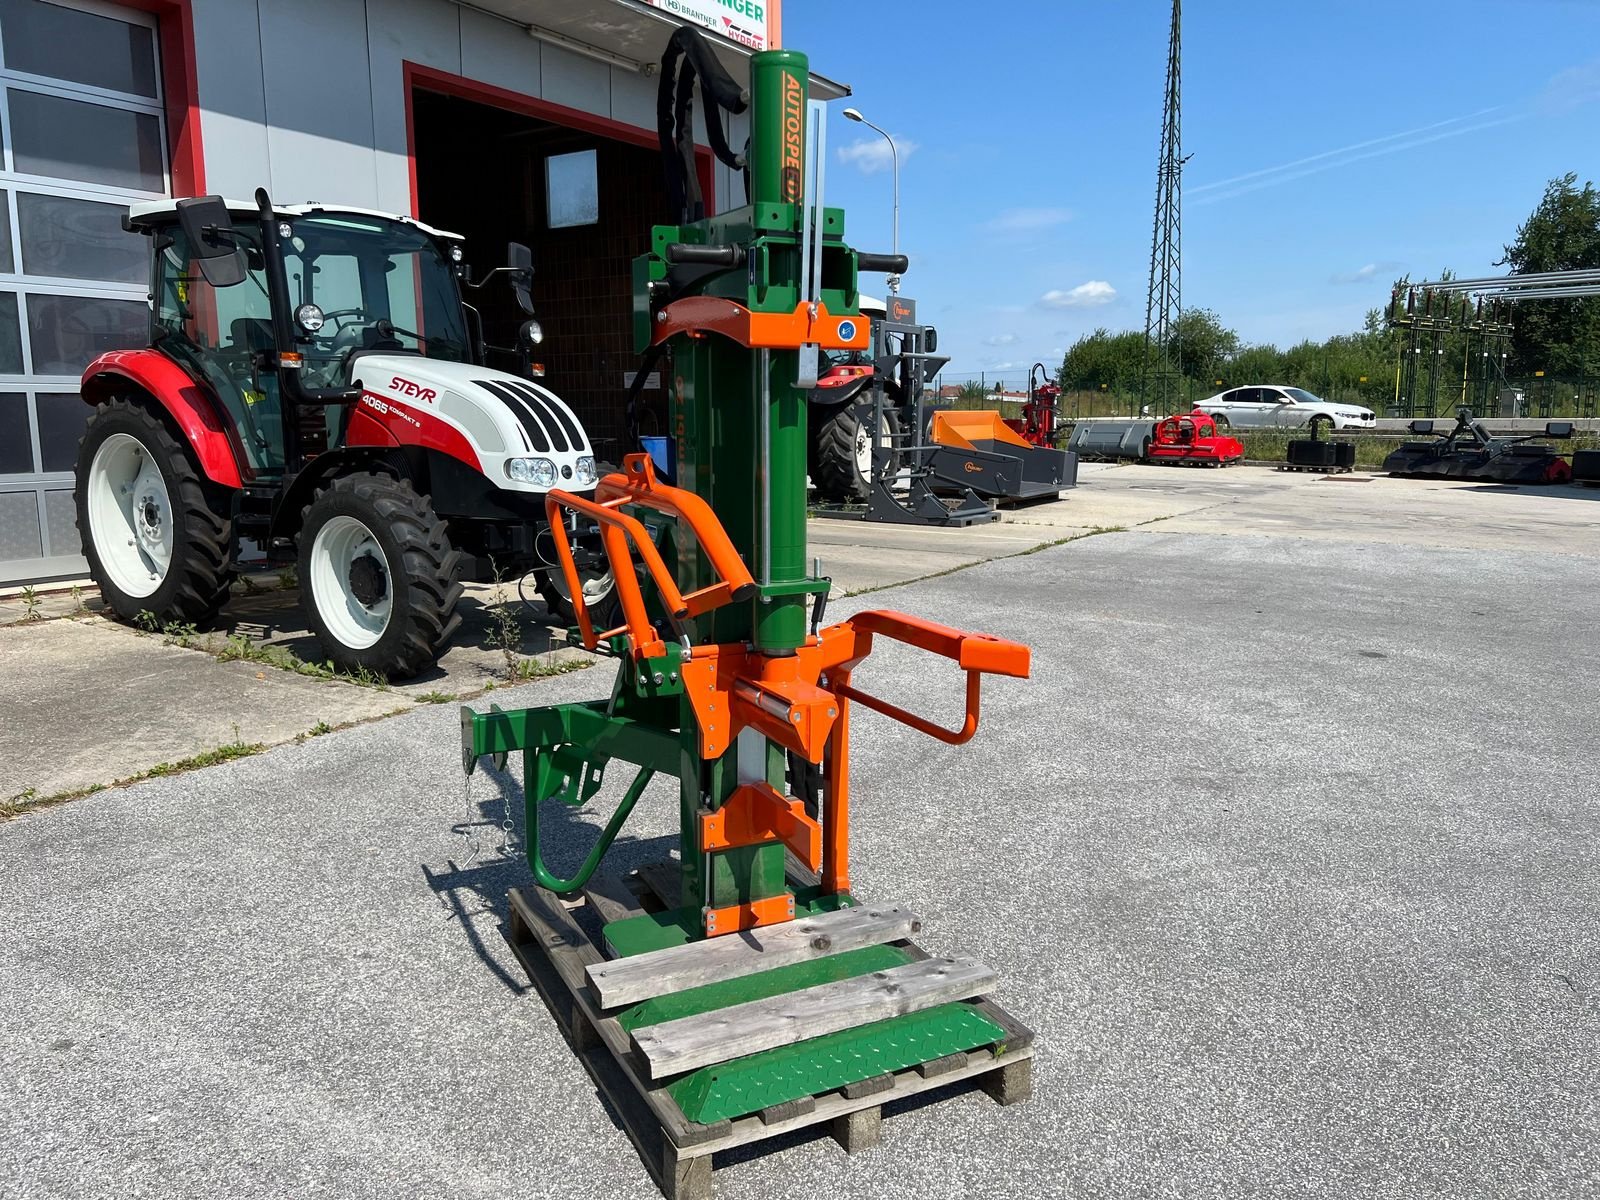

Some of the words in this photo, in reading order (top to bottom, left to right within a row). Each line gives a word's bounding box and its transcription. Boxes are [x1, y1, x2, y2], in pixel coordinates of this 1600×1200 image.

[682, 5, 718, 28] BRANTNER
[728, 29, 763, 50] HYDRAC
[786, 73, 801, 196] AUTOSPEED
[388, 376, 437, 404] STEYR
[362, 393, 389, 416] 4065
[389, 405, 416, 424] KOMPAKT
